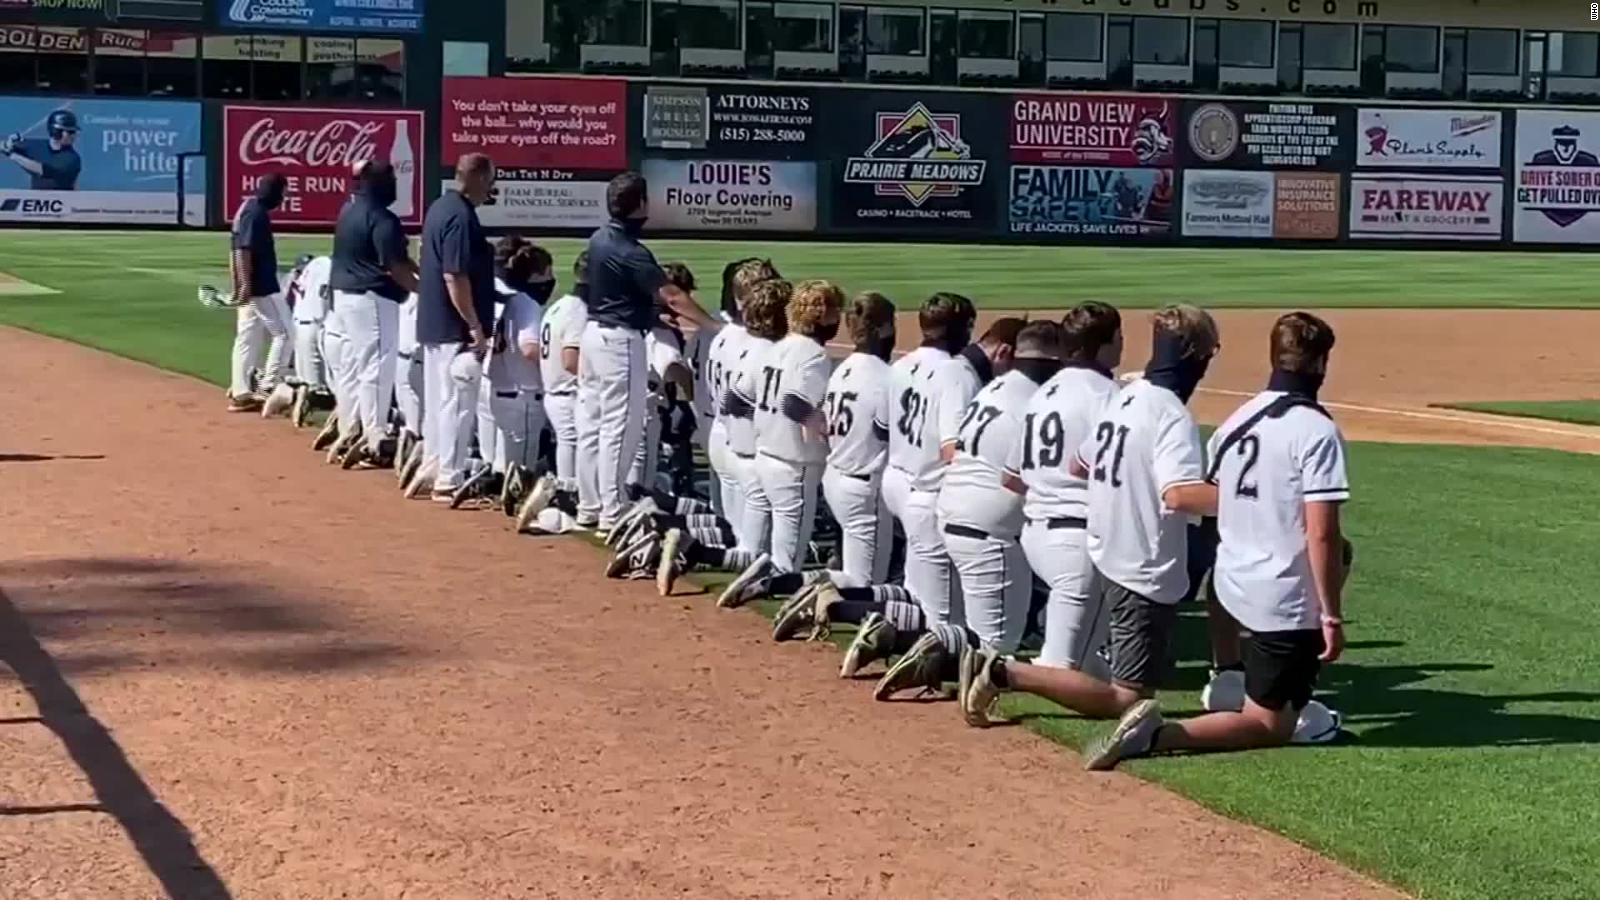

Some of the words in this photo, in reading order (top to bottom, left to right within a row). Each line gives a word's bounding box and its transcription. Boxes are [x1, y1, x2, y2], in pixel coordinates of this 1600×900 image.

[101, 32, 143, 49] Rule
[452, 99, 475, 111] You
[477, 100, 509, 112] don't
[512, 101, 537, 113] take
[539, 104, 568, 116] your
[570, 104, 597, 117] eyes
[599, 103, 617, 114] off
[717, 94, 810, 111] ATTORNEYS
[1014, 100, 1081, 122] GRAND
[1087, 102, 1136, 124] VIEW
[462, 116, 482, 127] the
[518, 117, 544, 131] why
[546, 118, 583, 129] would
[585, 119, 607, 132] you
[102, 129, 179, 152] power
[239, 118, 384, 167] Coca-Cola
[452, 132, 479, 143] take
[481, 133, 508, 146] your
[511, 135, 539, 147] eyes
[541, 132, 559, 144] off
[561, 134, 580, 145] the
[582, 133, 616, 146] road?
[719, 128, 750, 141] (515)
[752, 128, 806, 142] 288-5000
[1016, 124, 1130, 147] UNIVERSITY
[1386, 139, 1433, 155] Plumb
[1436, 140, 1486, 157] Supply
[124, 148, 192, 173] hitter
[689, 163, 772, 185] LOUIE'S
[850, 163, 908, 178] PRAIRIE
[910, 164, 980, 180] MEADOWS
[1521, 170, 1553, 186] DRIVE
[1555, 171, 1592, 187] SOBER
[242, 175, 301, 192] HE
[305, 177, 345, 193] RUN
[504, 187, 531, 197] FARM
[1013, 168, 1116, 200] FAMILY
[1278, 179, 1336, 190] INNOVATIVE
[504, 198, 556, 208] FINANCIAL
[666, 188, 712, 206] Floor
[716, 190, 793, 211] Covering
[1278, 190, 1336, 201] INSURANCE
[1362, 189, 1492, 212] FAREWAY
[1517, 187, 1538, 203] GET
[1540, 188, 1582, 204] PULLED
[22, 200, 64, 213] EMC
[857, 209, 888, 217] CASINO
[895, 209, 940, 218] RACETRACK
[947, 210, 972, 218] HOTEL
[1277, 201, 1335, 212] SOLUTIONS
[1186, 212, 1221, 223] Farmers
[1222, 213, 1251, 223] Mutual
[1253, 213, 1271, 224] Hail
[1380, 214, 1409, 223] MET
[1423, 215, 1472, 225] GROCERY
[1011, 223, 1032, 232] LIFE
[1034, 223, 1080, 234] JACKETS
[1082, 225, 1107, 234] SAVE
[1109, 225, 1137, 234] LIVES
[541, 322, 552, 360] 9
[956, 401, 1002, 456] 27
[1022, 410, 1065, 471] 19
[1094, 420, 1130, 488] 21
[1235, 434, 1259, 499] 2
